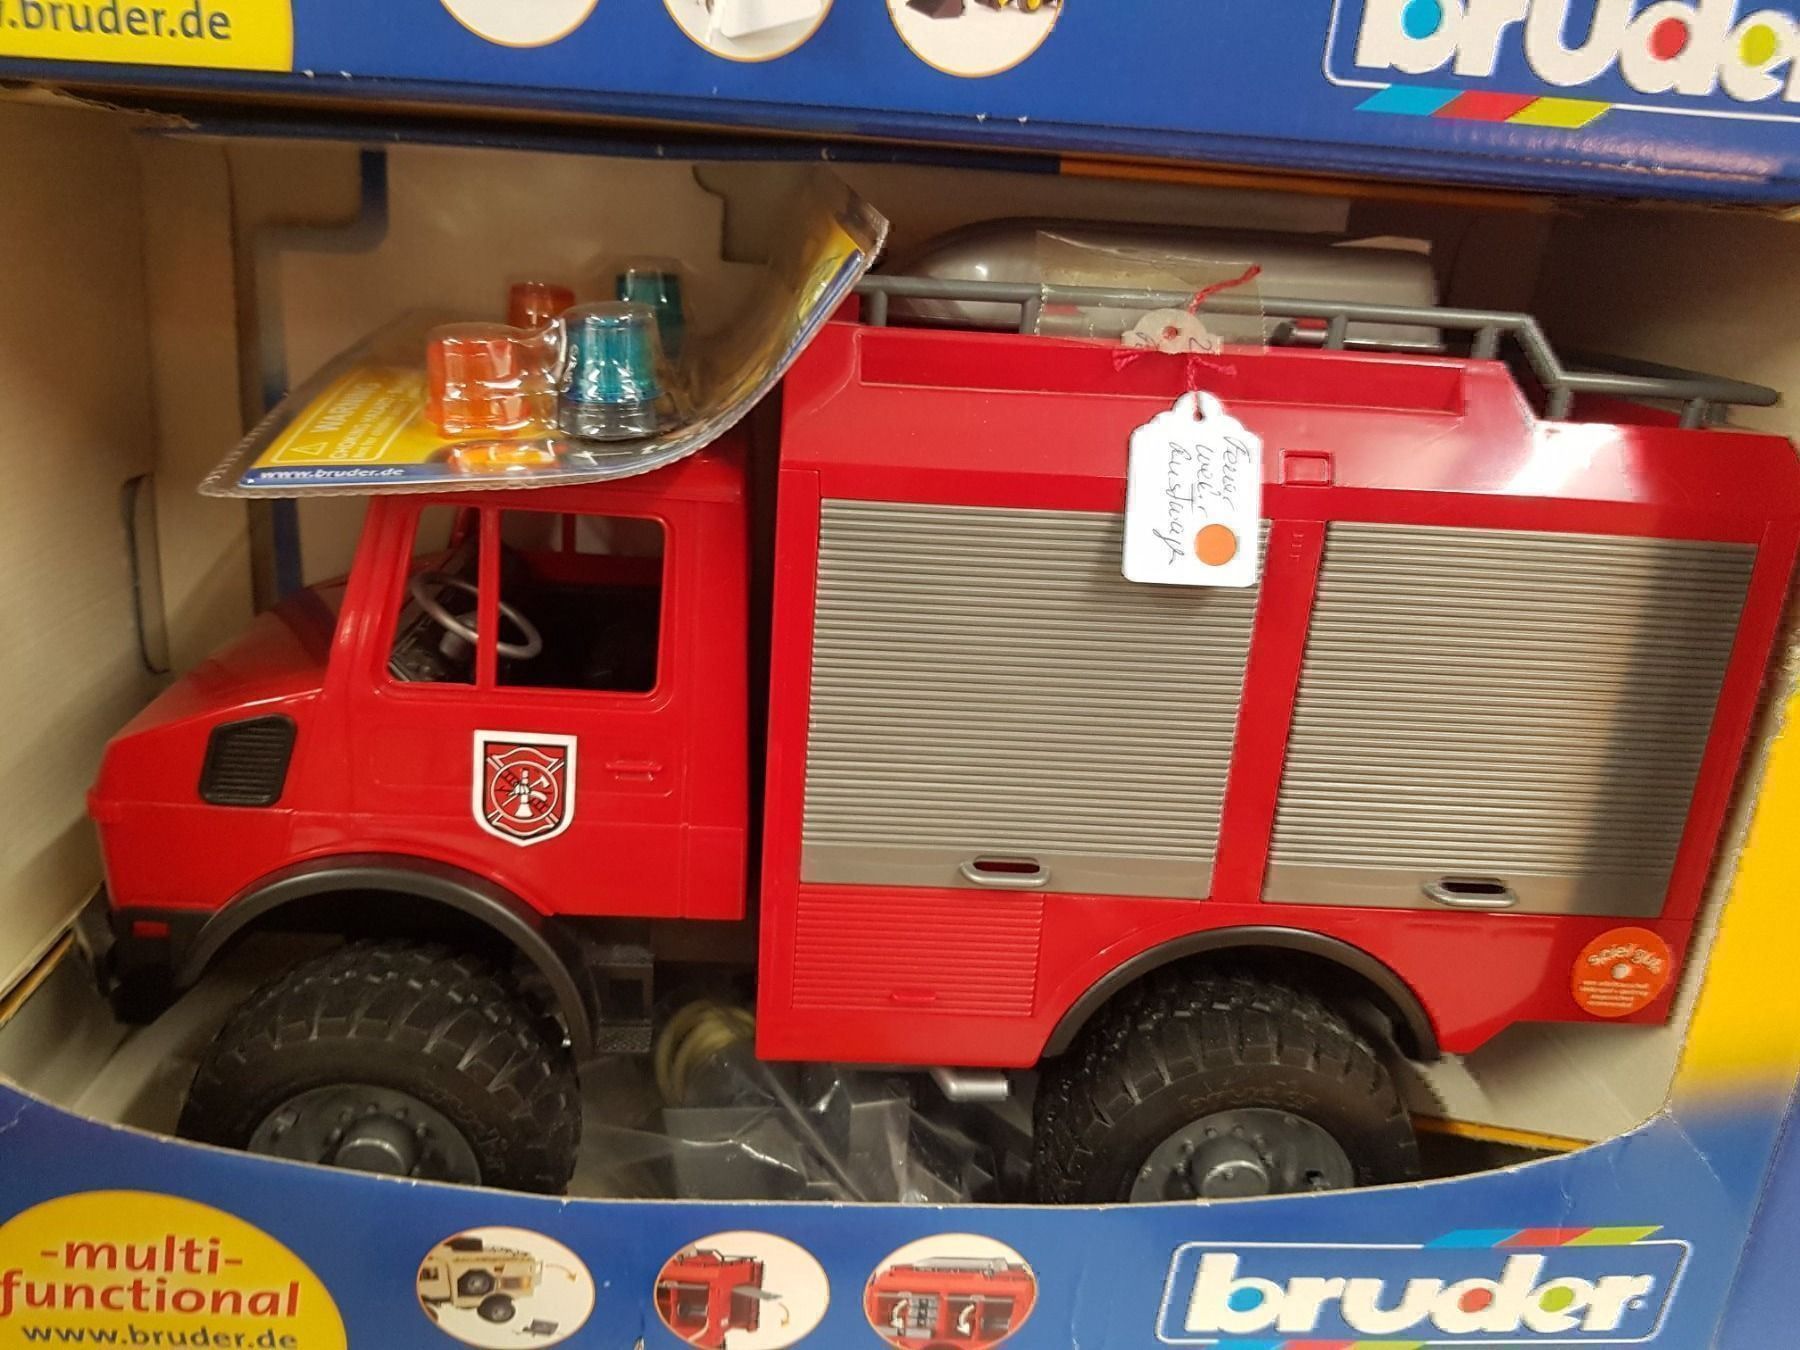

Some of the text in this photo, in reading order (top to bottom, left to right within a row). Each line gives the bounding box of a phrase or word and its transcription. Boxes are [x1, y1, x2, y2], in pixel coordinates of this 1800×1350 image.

[0, 0, 231, 40] .bruder.de
[260, 467, 405, 480] www.bruder.de
[0, 1268, 299, 1319] functional
[1185, 1253, 1652, 1334] bruder
[22, 1323, 297, 1349] www.bruder.de
